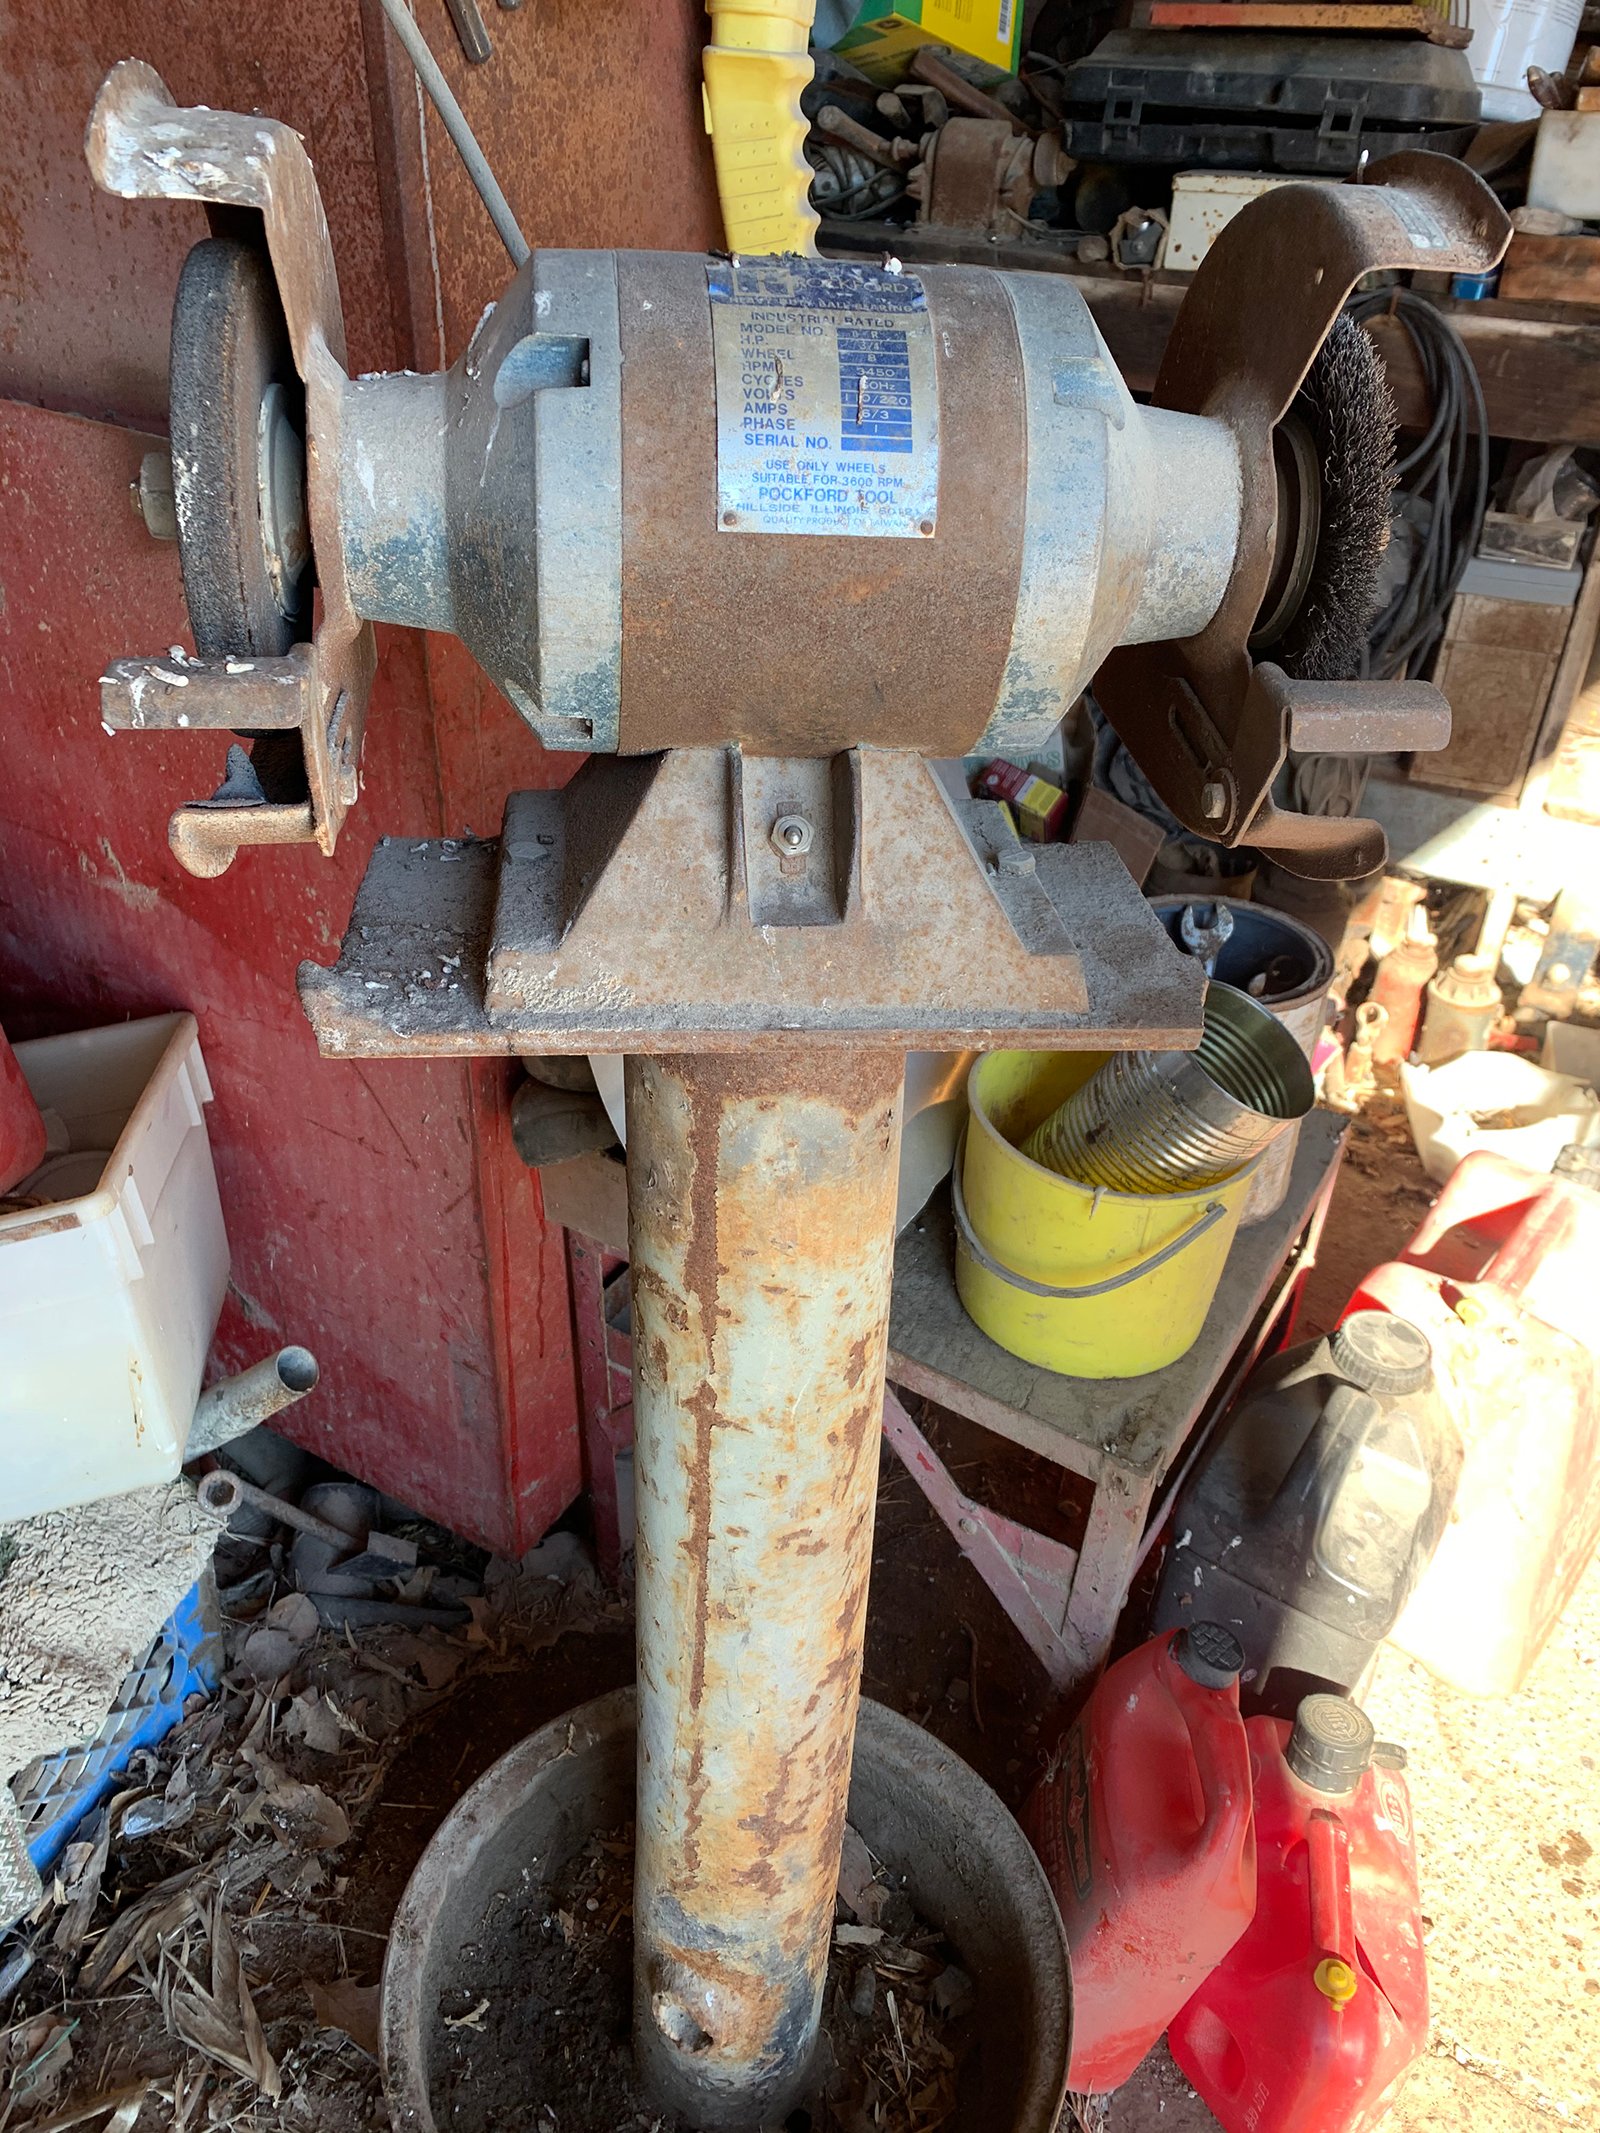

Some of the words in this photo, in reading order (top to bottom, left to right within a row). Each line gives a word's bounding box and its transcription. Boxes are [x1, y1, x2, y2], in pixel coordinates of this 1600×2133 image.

[740, 323, 796, 336] MODEL
[801, 326, 828, 336] NO.
[740, 334, 769, 345] H.P.
[741, 348, 796, 360] WHEEL
[742, 360, 775, 372] RPM
[857, 367, 895, 377] 3450
[741, 373, 804, 388] CYCES
[743, 388, 796, 401] VOLS
[743, 402, 788, 415] AMPS
[861, 408, 889, 420] 6/3
[743, 417, 796, 431] PHASE
[744, 433, 799, 448] SERIAL
[805, 436, 832, 449] NO.
[765, 459, 790, 470] USE
[796, 460, 829, 472] ONLY
[835, 462, 886, 475] WHEELS
[751, 472, 808, 485] SUITABLE
[812, 474, 838, 486] FOR
[841, 476, 873, 488] 3600
[877, 477, 903, 488] RPM
[856, 489, 899, 505] TOOL
[735, 502, 801, 513] HILLSIDE
